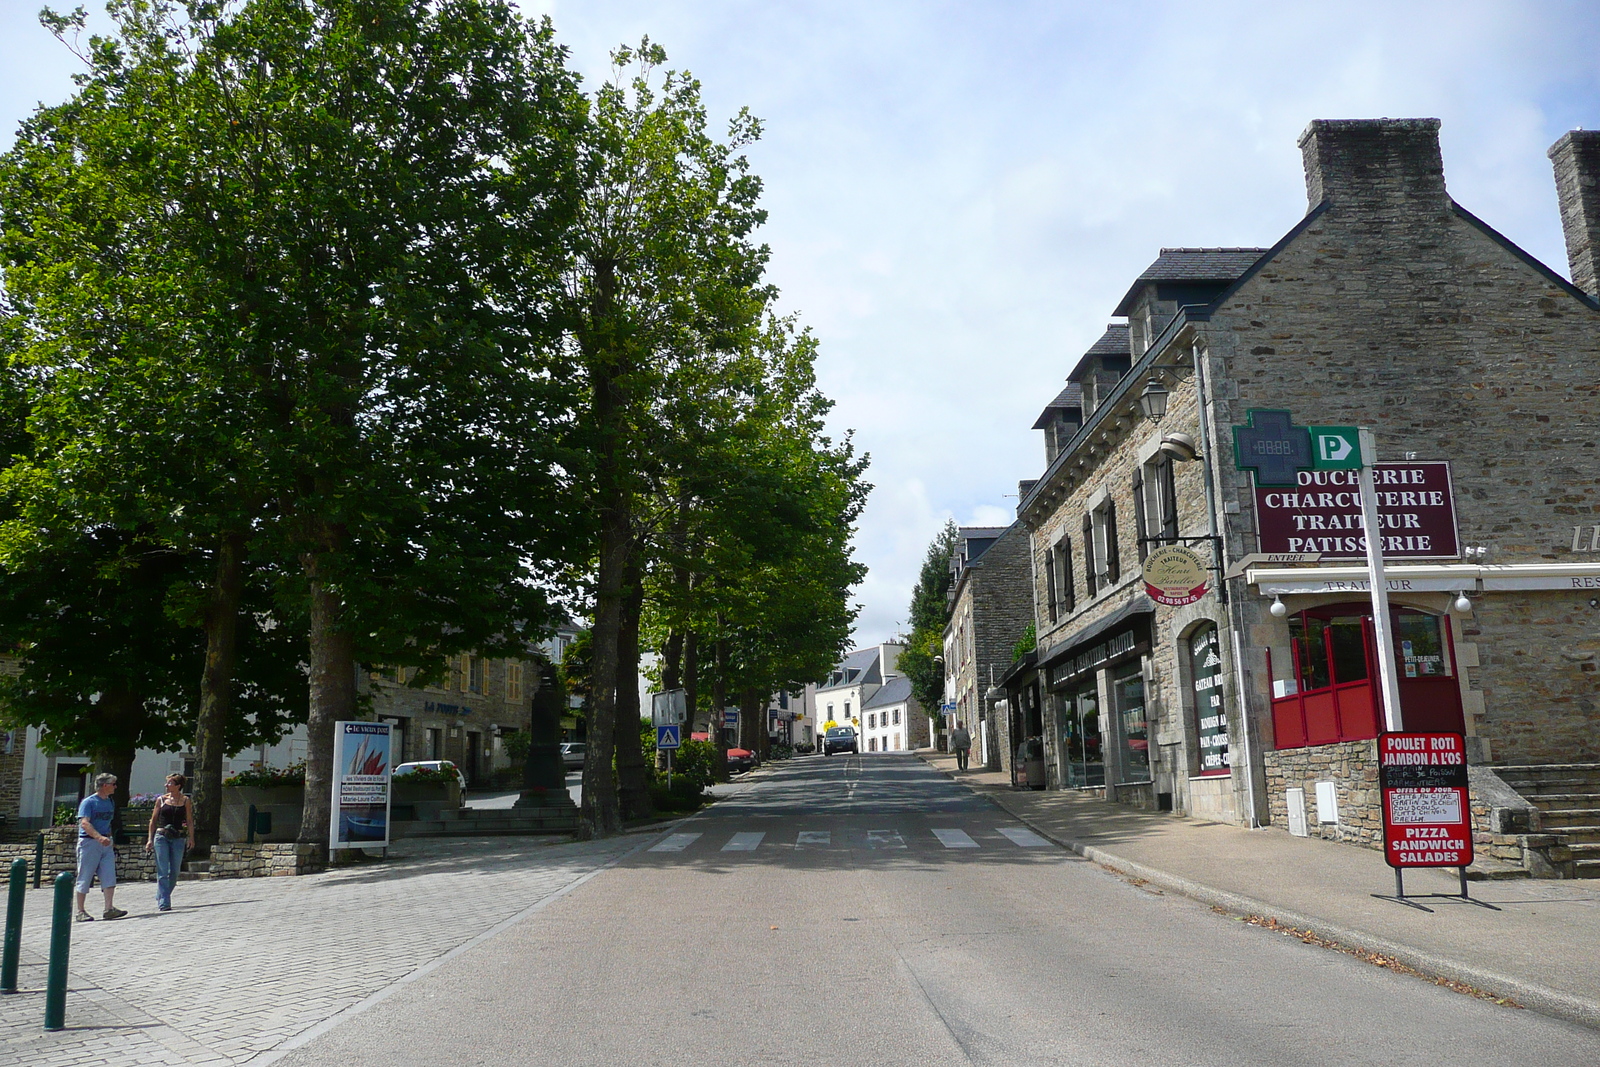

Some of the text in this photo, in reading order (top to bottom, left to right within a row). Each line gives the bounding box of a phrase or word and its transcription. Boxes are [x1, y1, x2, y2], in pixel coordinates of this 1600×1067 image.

[1323, 436, 1341, 459] P
[1298, 469, 1425, 486] OUCHRIE
[1265, 491, 1444, 508] CHARCUTERIE
[1146, 547, 1203, 572] BOUCHERIE CHARCUTERIE
[1160, 556, 1187, 565] TRAITEUR
[1323, 580, 1413, 591] TRAIUR
[1157, 595, 1165, 603] 02
[1209, 630, 1217, 643] DE
[1210, 694, 1220, 708] FAR
[1387, 737, 1455, 750] POULET ROTI
[1383, 752, 1461, 766] JAMBON A L'OS
[1405, 828, 1449, 838] PIZZA
[1392, 839, 1465, 851] SANDWICH
[1399, 852, 1459, 863] SALADES
